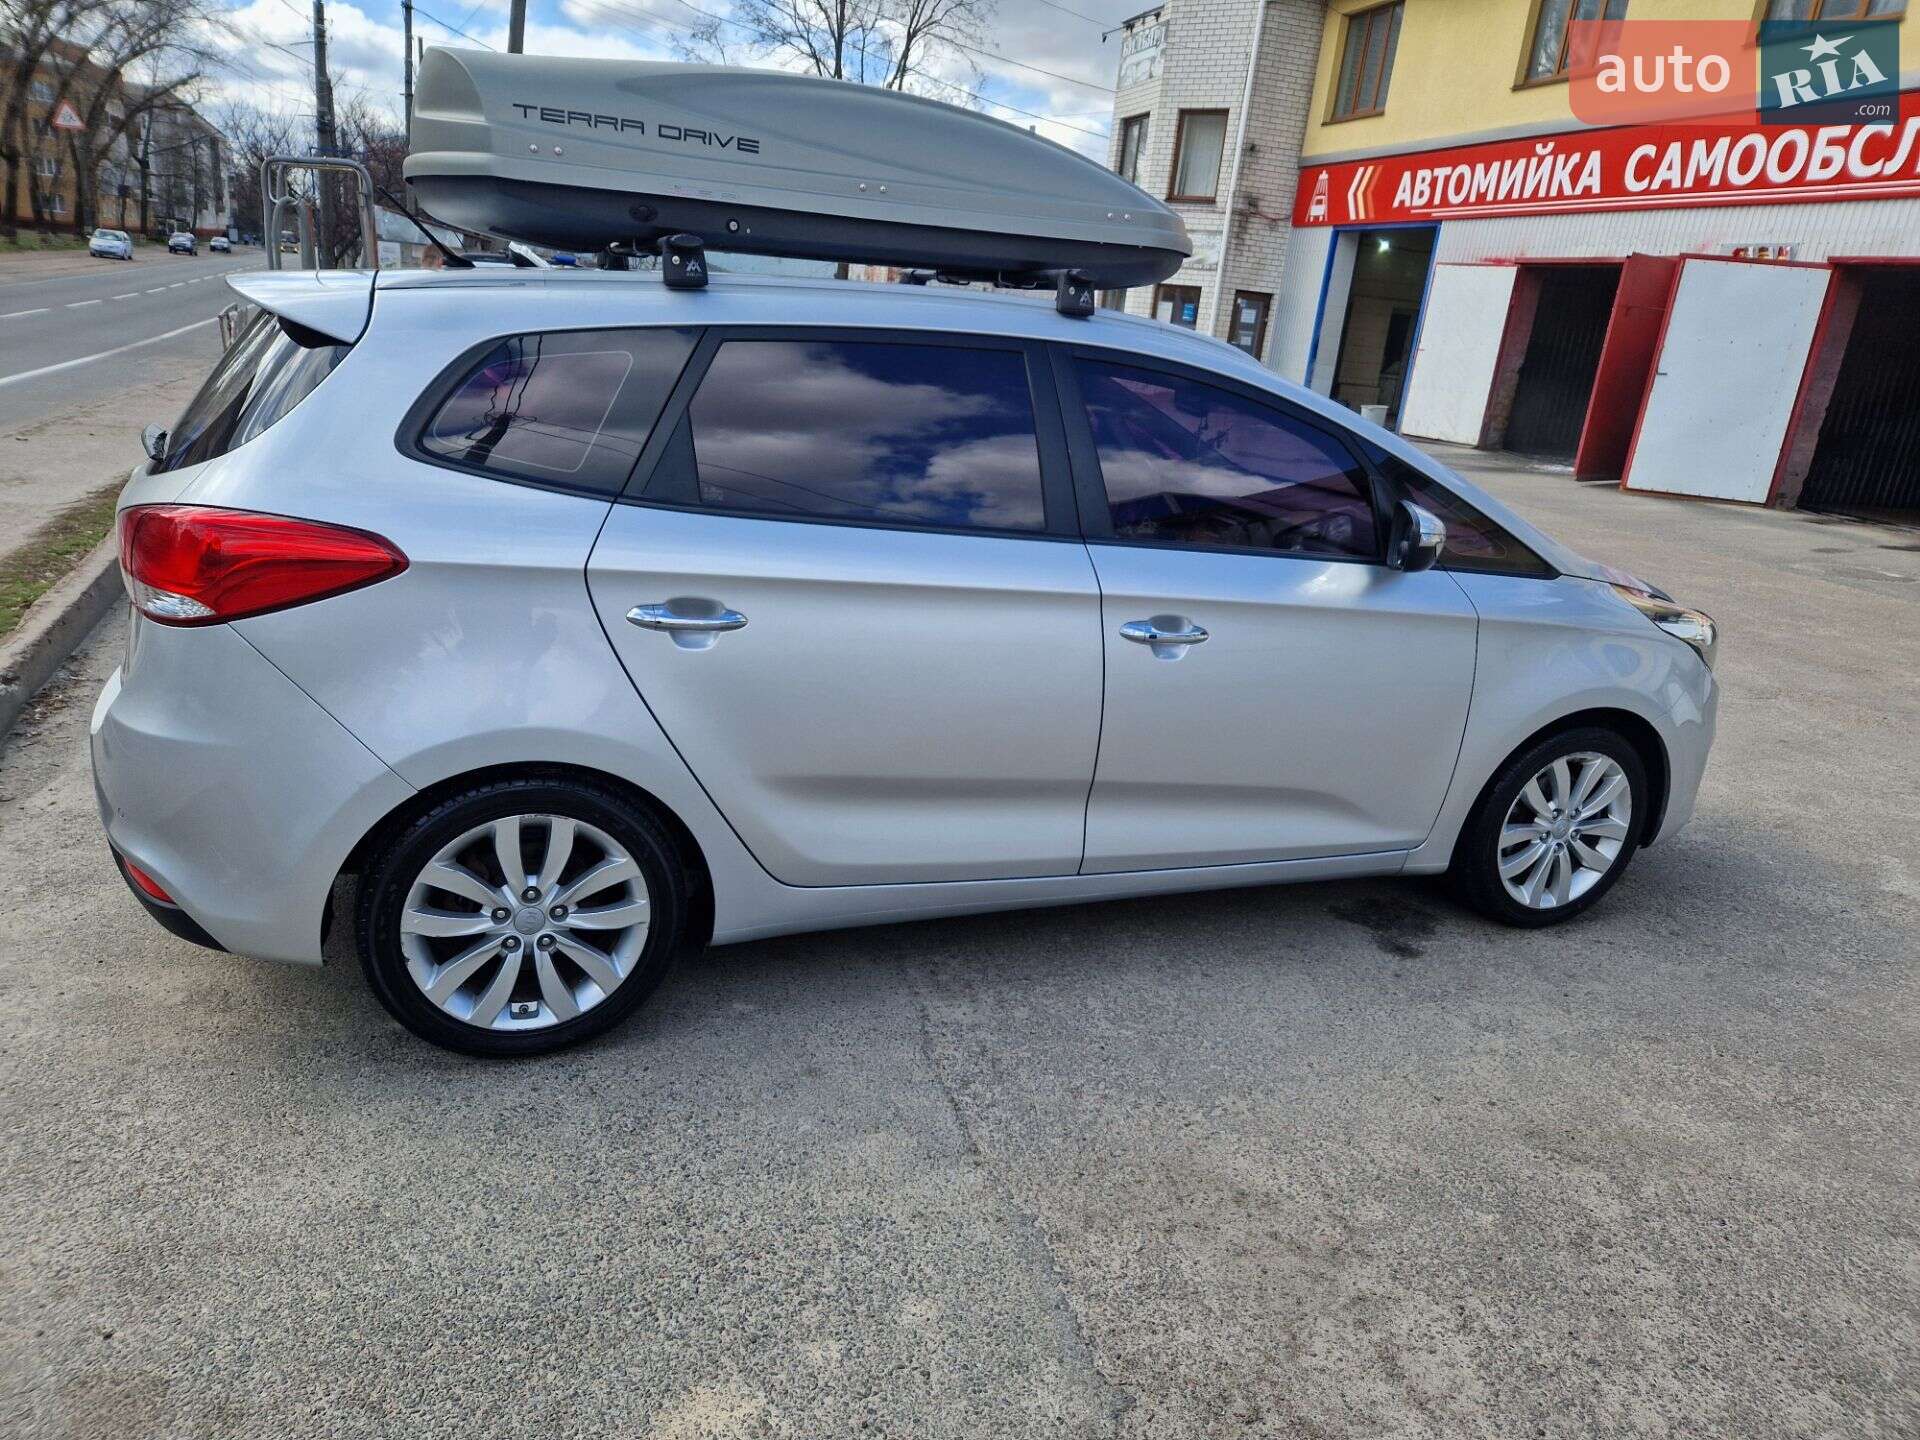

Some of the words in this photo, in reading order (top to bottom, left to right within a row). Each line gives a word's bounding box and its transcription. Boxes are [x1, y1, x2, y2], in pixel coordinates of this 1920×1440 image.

[512, 103, 645, 136] TERRA
[657, 123, 760, 154] DRIVE
[1392, 142, 1601, 208] АВТОМИЙКА
